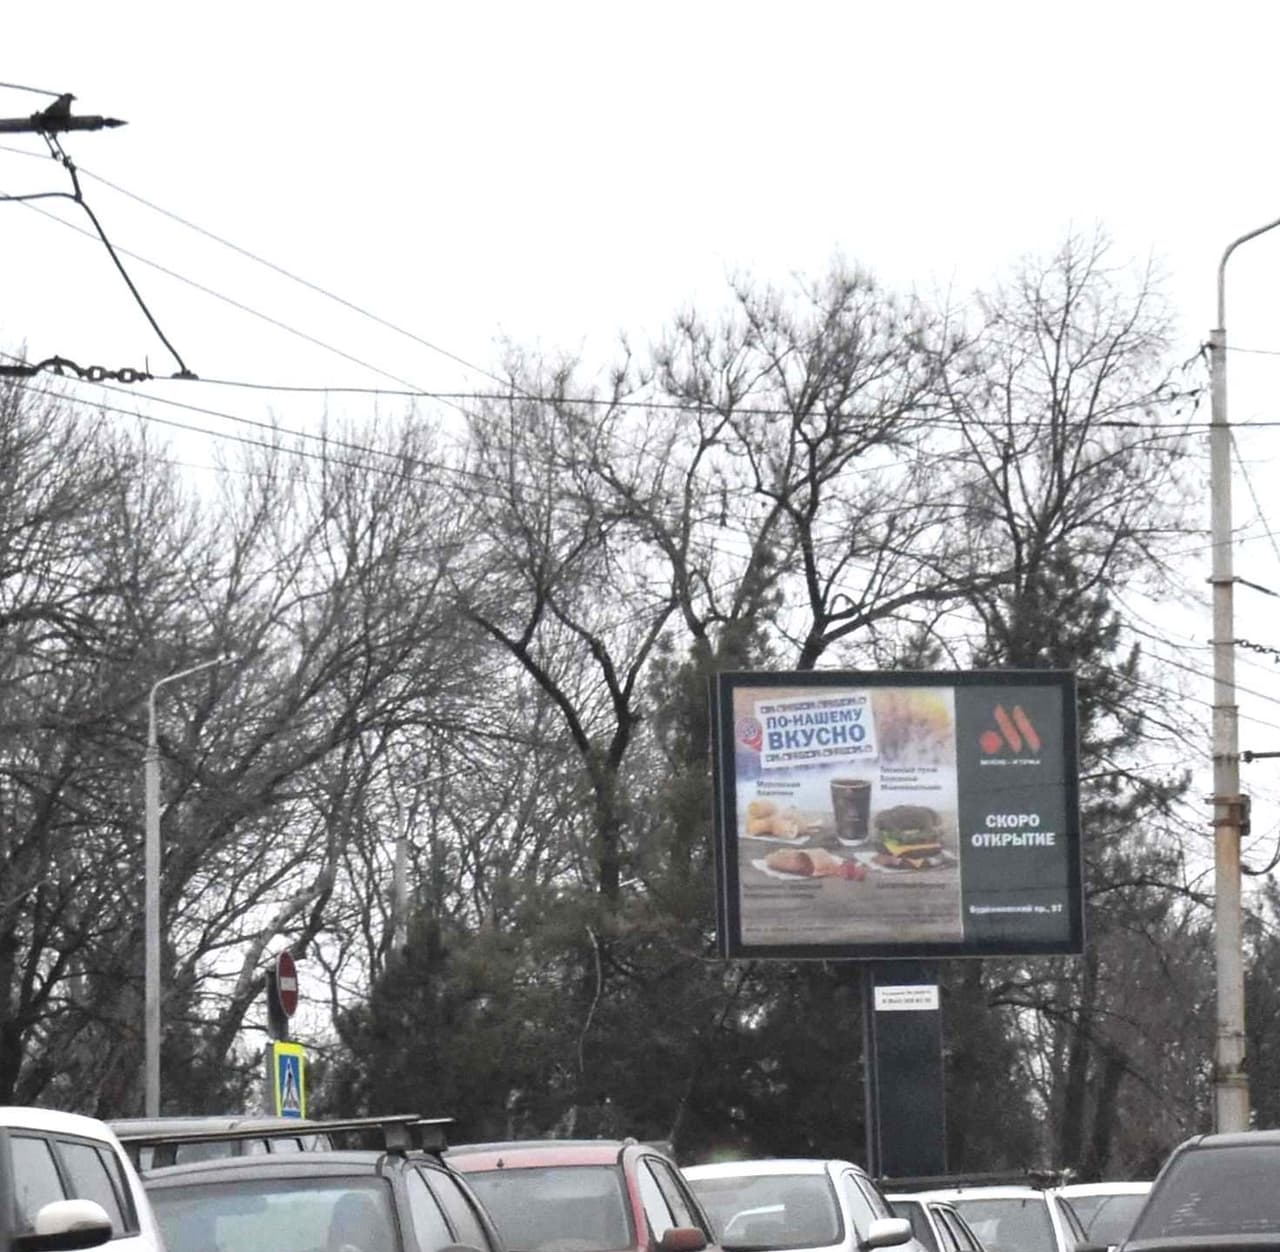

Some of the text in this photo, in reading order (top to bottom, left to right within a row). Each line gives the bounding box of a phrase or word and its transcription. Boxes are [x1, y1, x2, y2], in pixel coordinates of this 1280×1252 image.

[766, 708, 863, 729] ПО-НАШЕМУ
[767, 723, 866, 751] ВКУСНО
[984, 813, 1041, 828] СКОРО
[970, 832, 1057, 847] ОТКРЫТИЕ
